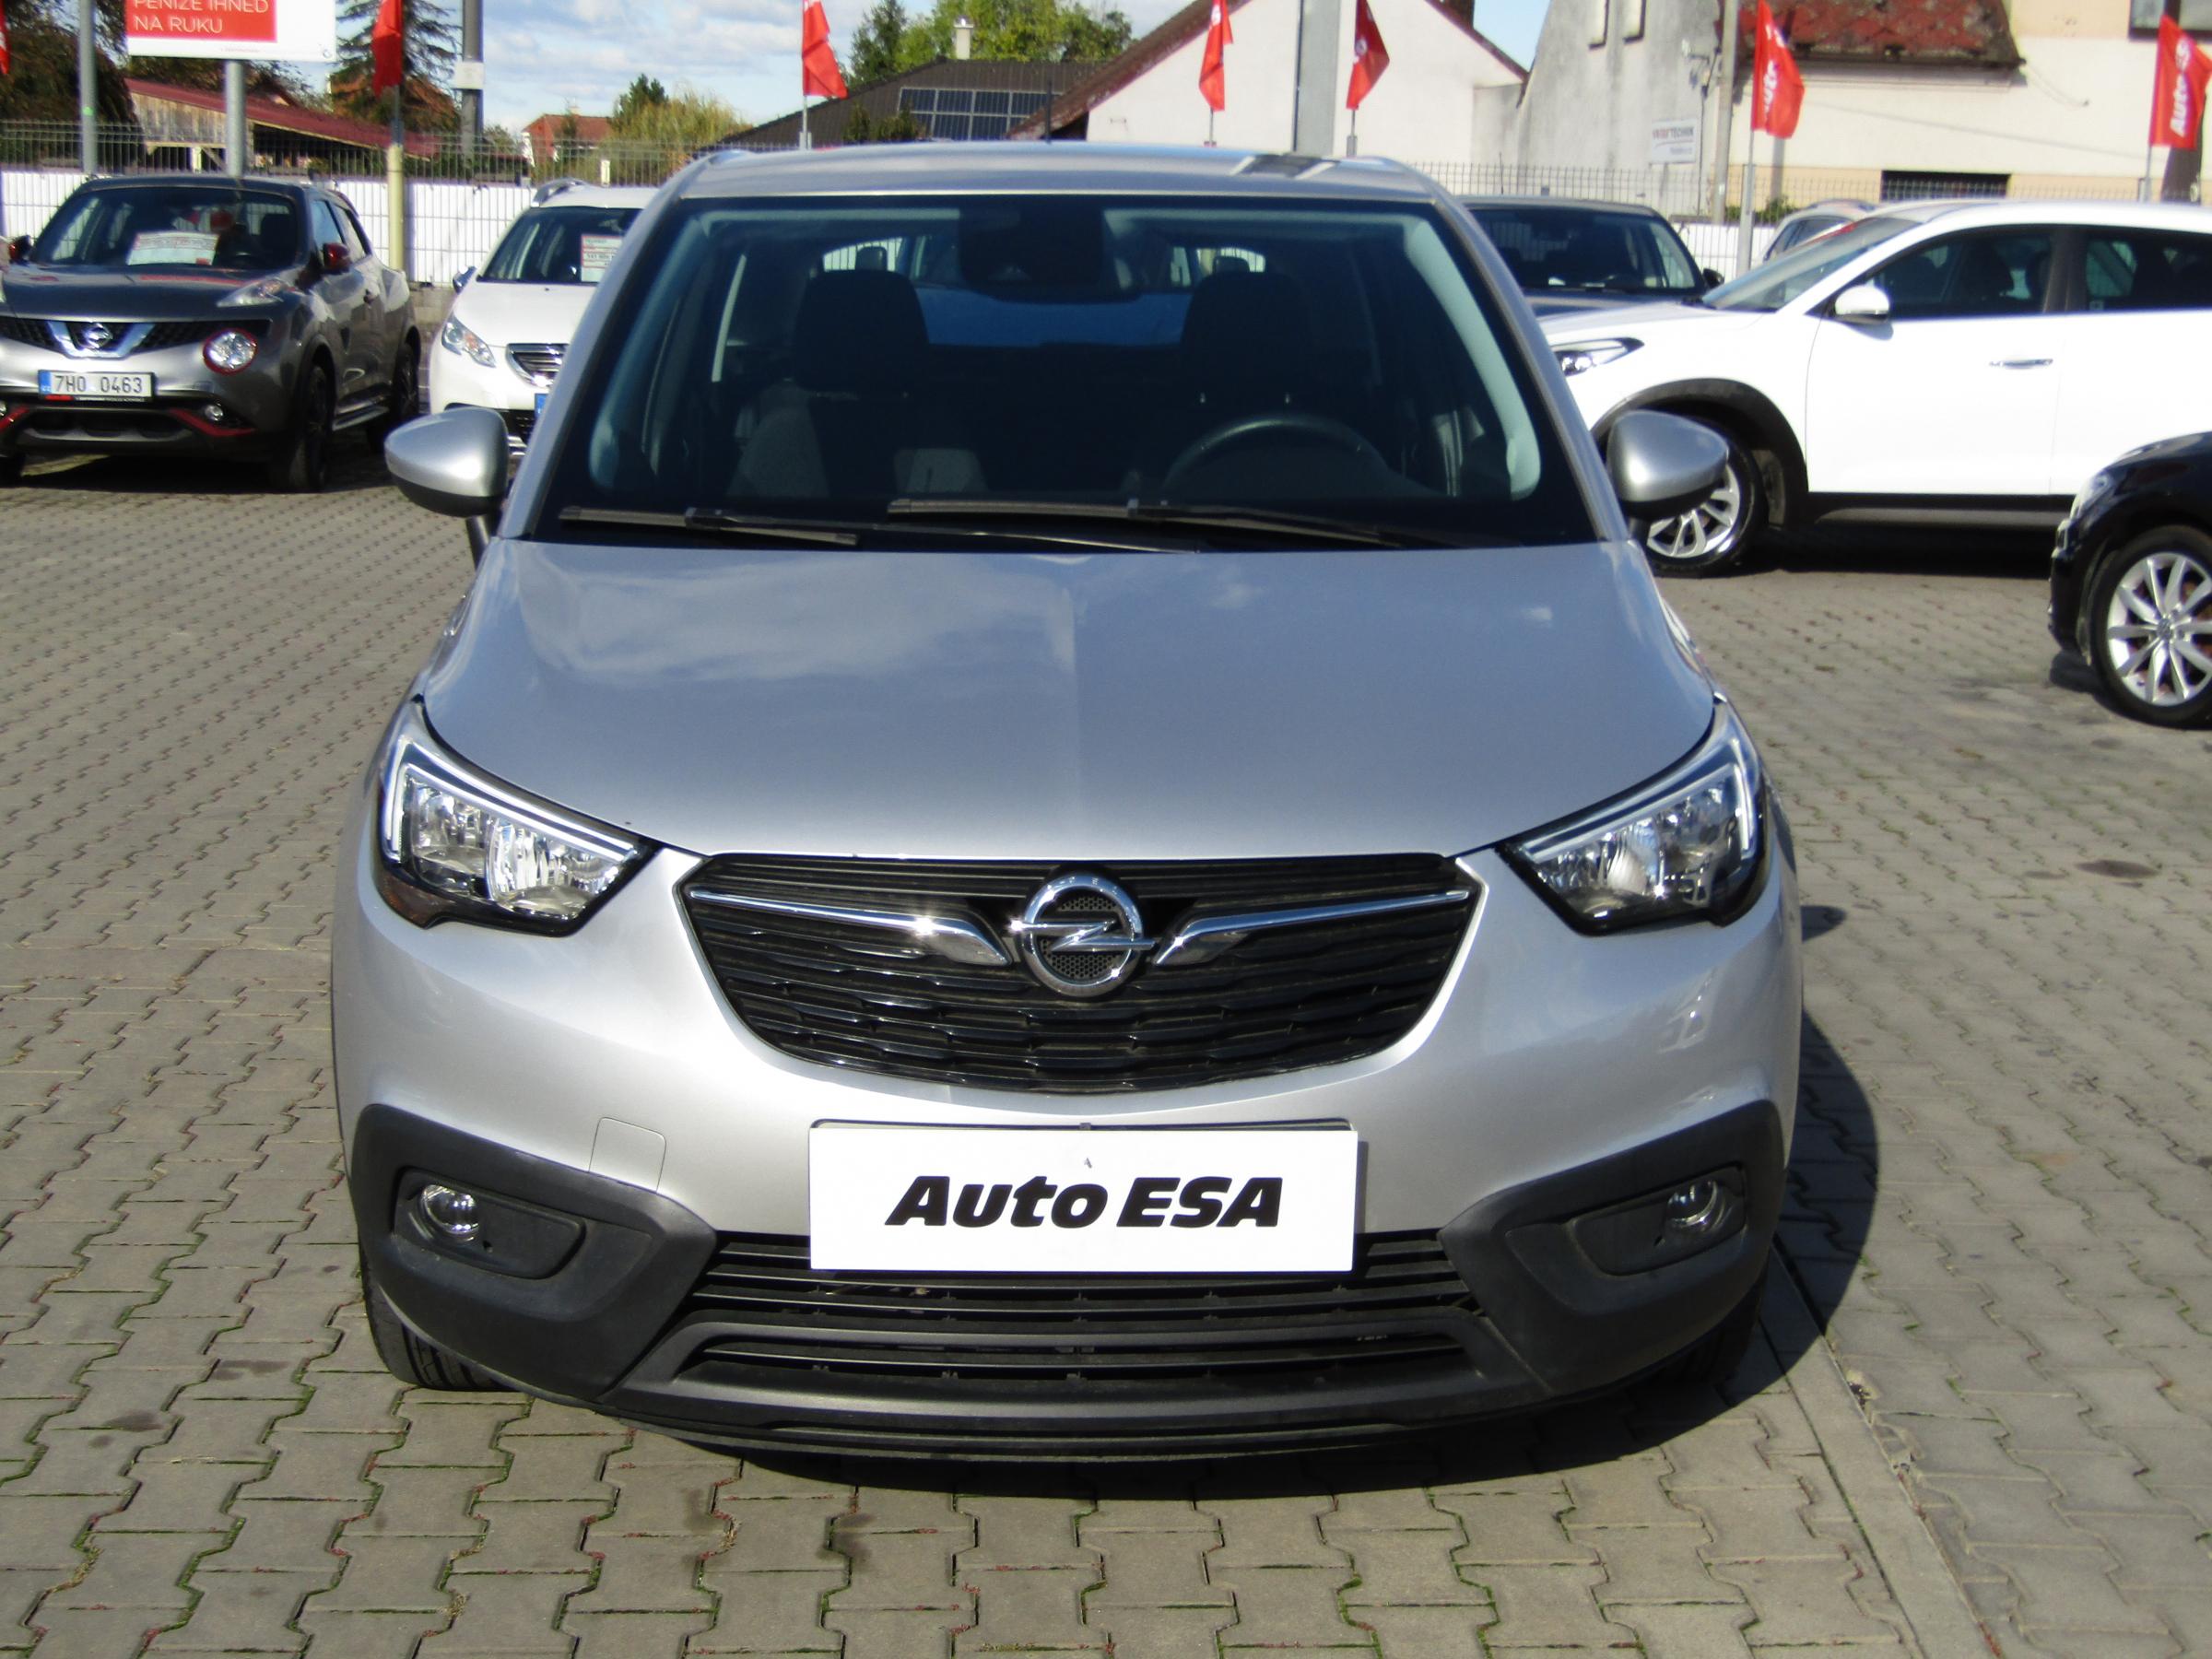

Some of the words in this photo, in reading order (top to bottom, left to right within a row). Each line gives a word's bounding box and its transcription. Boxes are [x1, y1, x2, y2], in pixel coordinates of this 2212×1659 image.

[134, 15, 163, 31] NA
[170, 16, 223, 34] RUKU
[100, 376, 143, 394] 0463
[884, 1175, 1109, 1229] Auto
[1116, 1176, 1284, 1229] ESA
